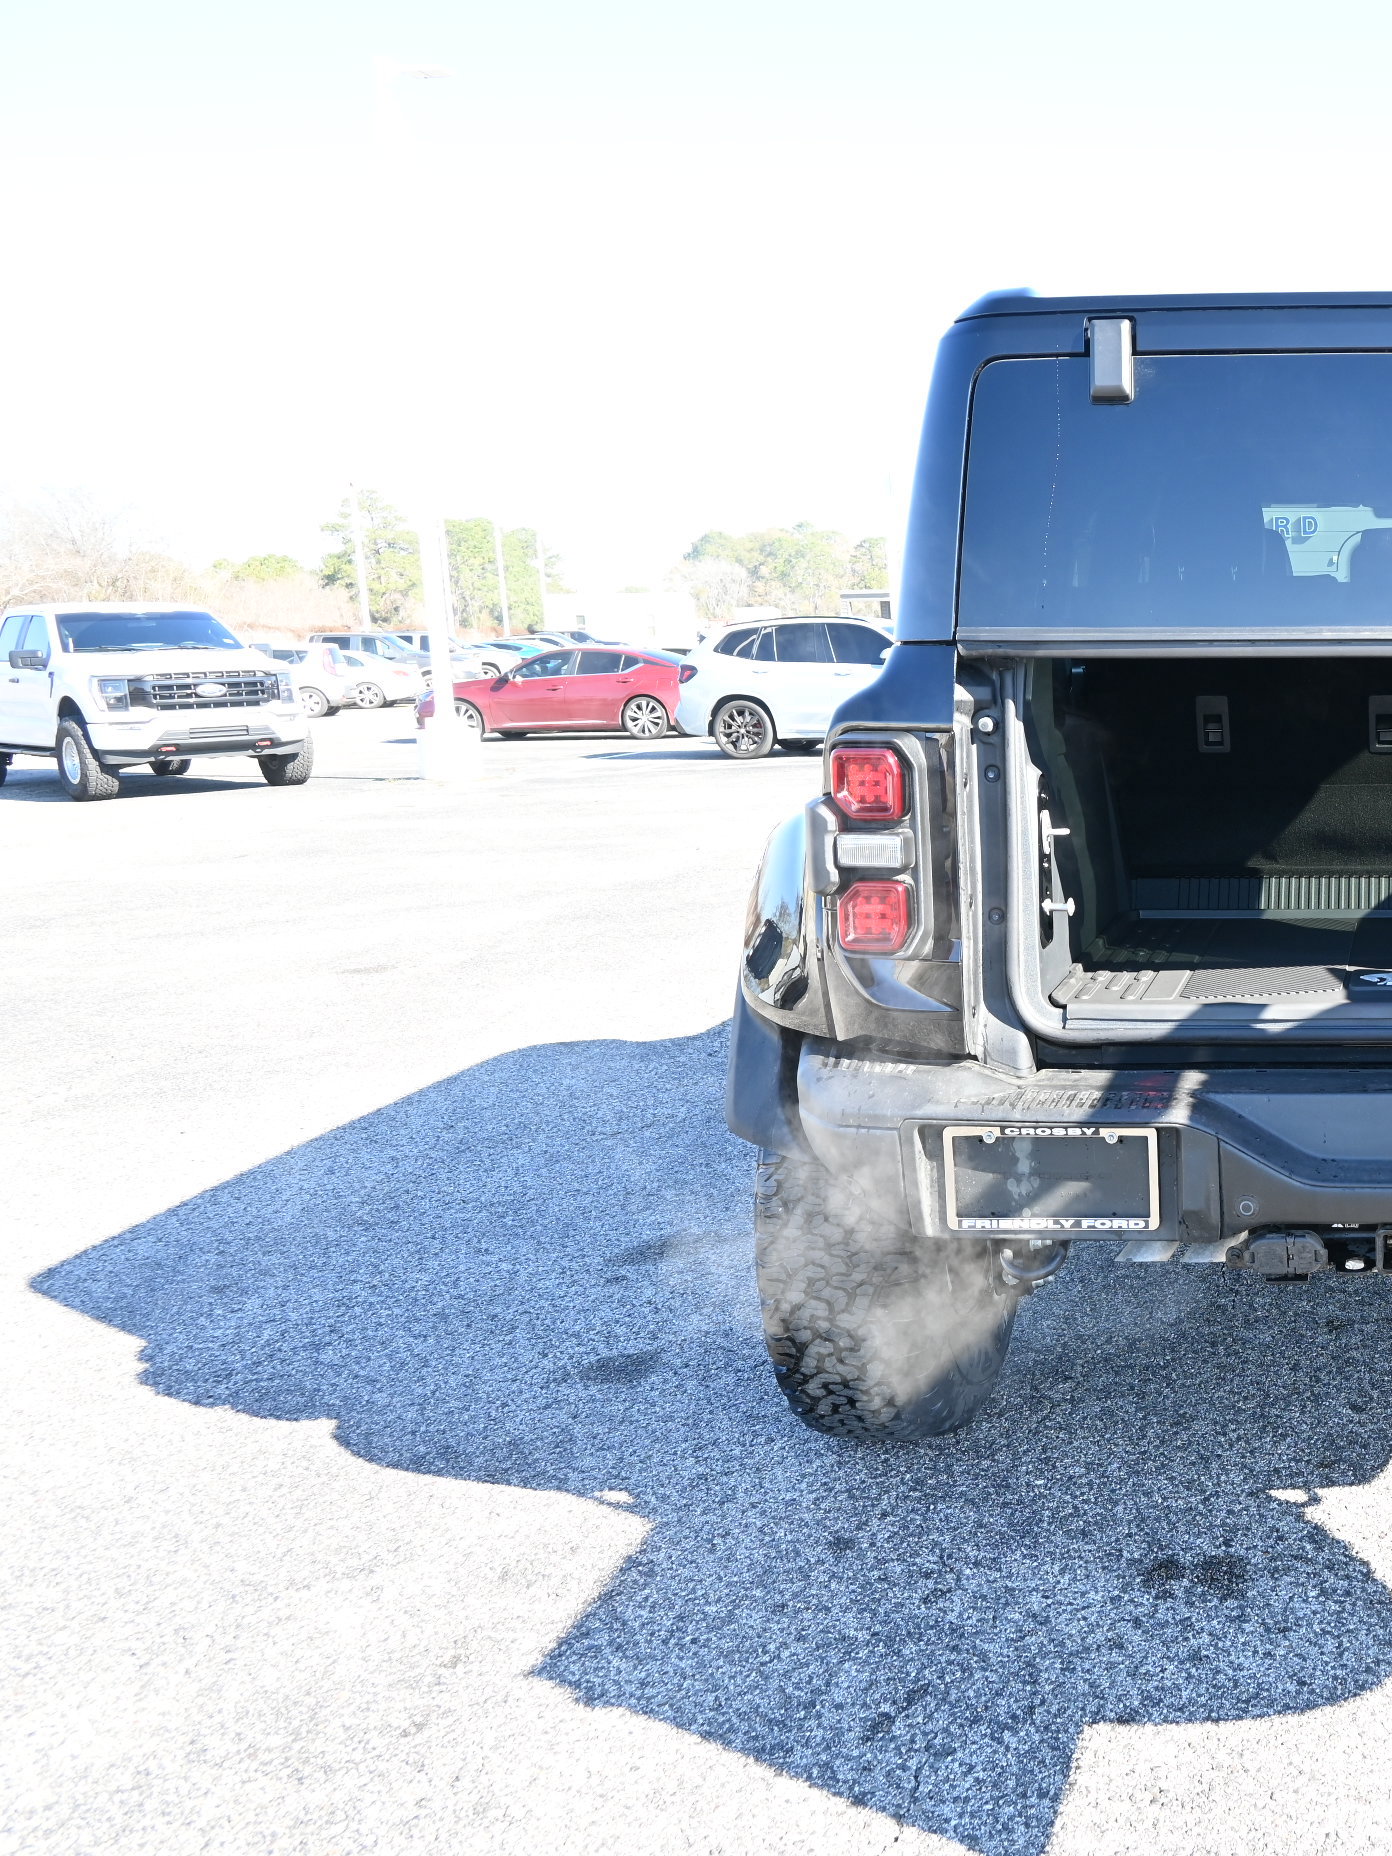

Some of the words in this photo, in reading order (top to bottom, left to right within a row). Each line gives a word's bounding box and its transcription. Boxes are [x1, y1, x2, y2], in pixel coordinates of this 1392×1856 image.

[1004, 1127, 1096, 1136] CROSBY
[961, 1218, 1075, 1230] FRIENDLY
[1081, 1218, 1146, 1229] FORD
